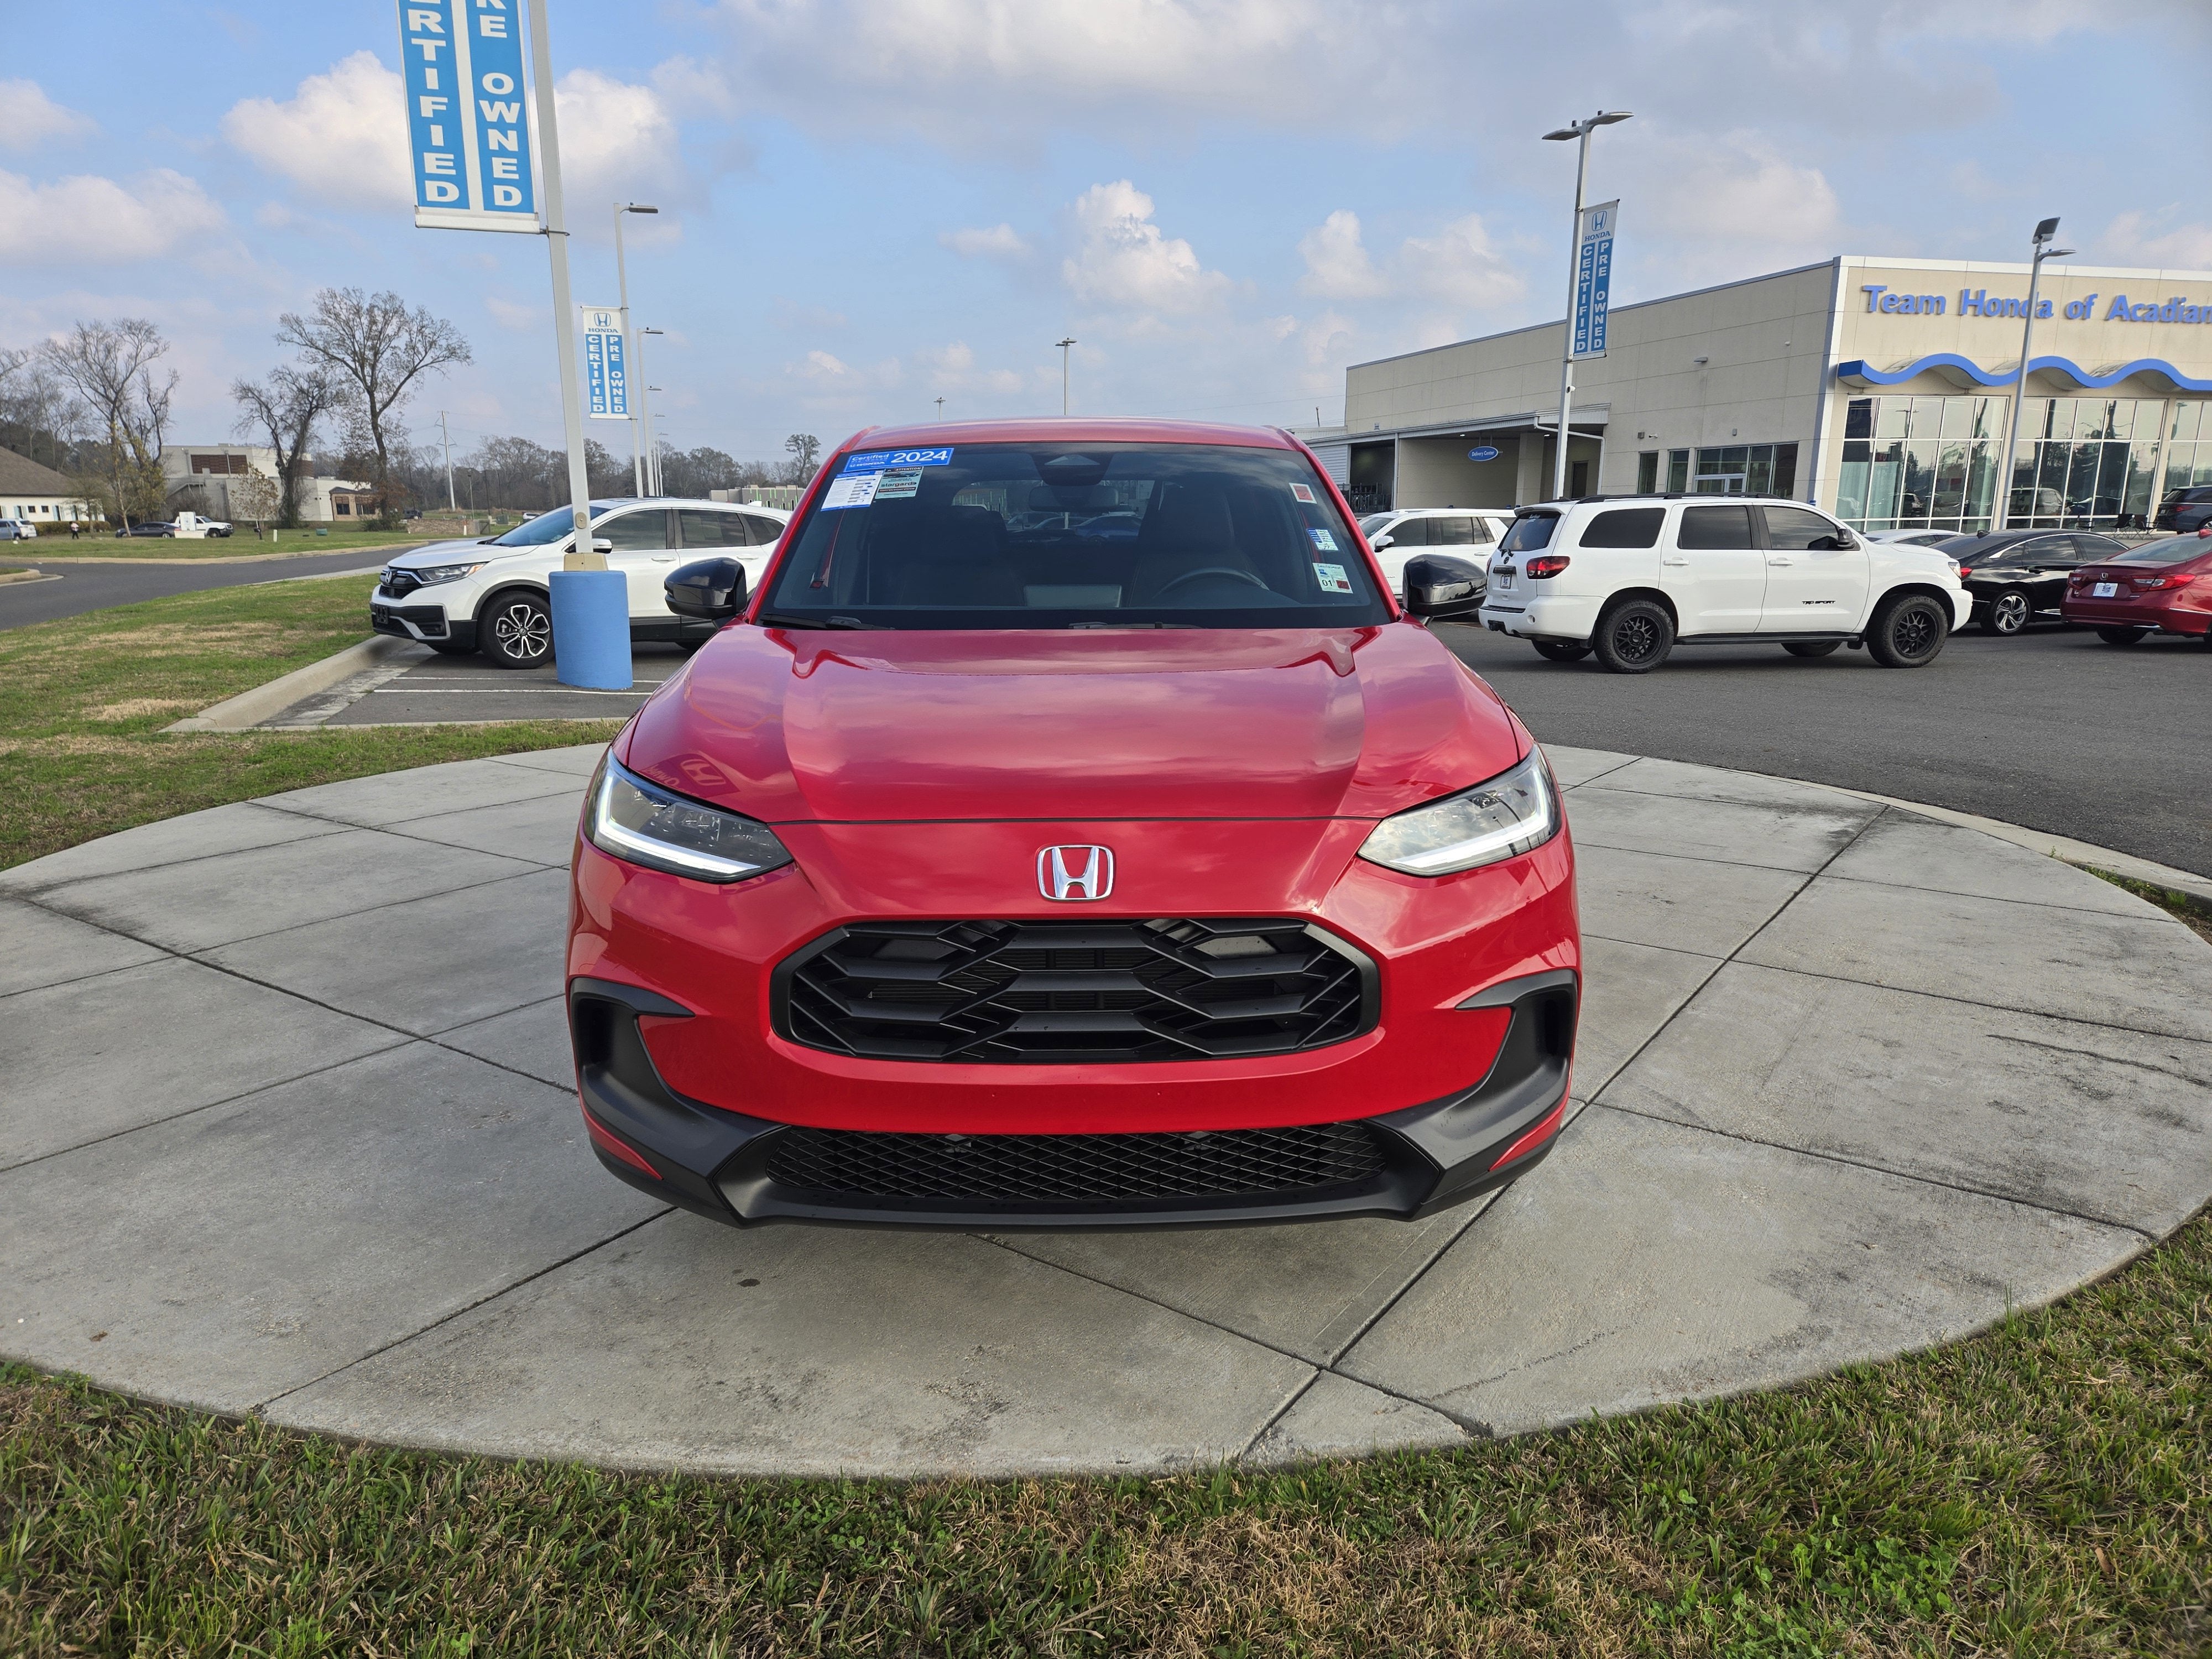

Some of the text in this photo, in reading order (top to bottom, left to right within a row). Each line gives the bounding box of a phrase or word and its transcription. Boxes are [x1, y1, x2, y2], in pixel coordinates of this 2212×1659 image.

[408, 0, 460, 202] RTIFIED
[478, 72, 523, 207] OWNED
[1584, 231, 1611, 242] HONDA
[1576, 246, 1593, 351] CERTIFIED
[1594, 242, 1609, 348] PRE OWNED
[1861, 285, 1947, 314] Team
[2065, 293, 2099, 320] of
[587, 336, 604, 412] CERTIFIED
[609, 336, 624, 413] PRE OWNED
[852, 453, 890, 462] Certified
[891, 451, 948, 463] 2024
